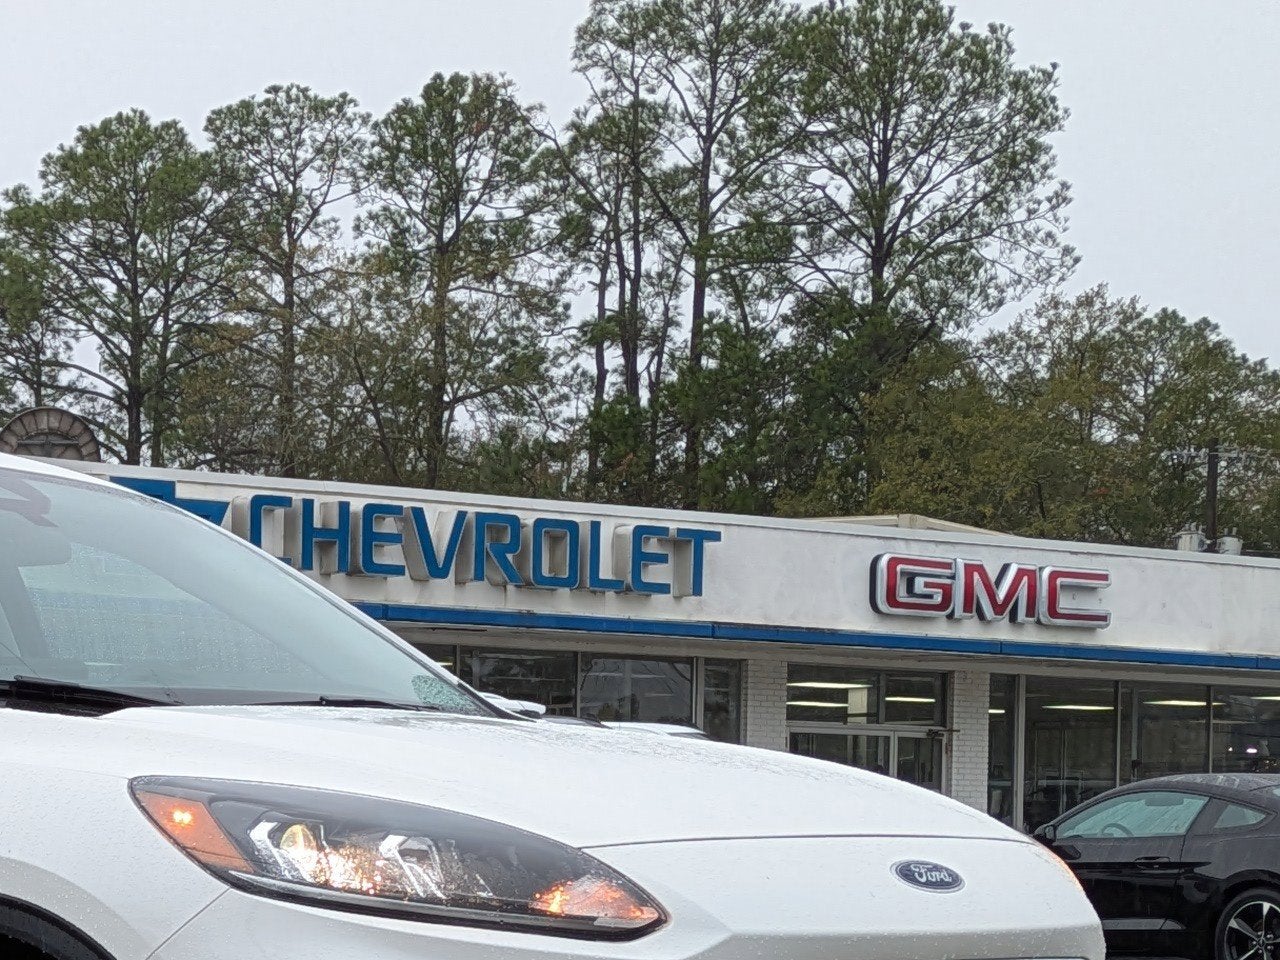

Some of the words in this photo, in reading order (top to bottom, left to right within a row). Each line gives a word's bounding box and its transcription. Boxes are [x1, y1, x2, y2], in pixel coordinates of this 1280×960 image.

[249, 493, 722, 598] CHEVROLET
[873, 552, 1113, 630] GMC
[910, 863, 952, 883] Ford
